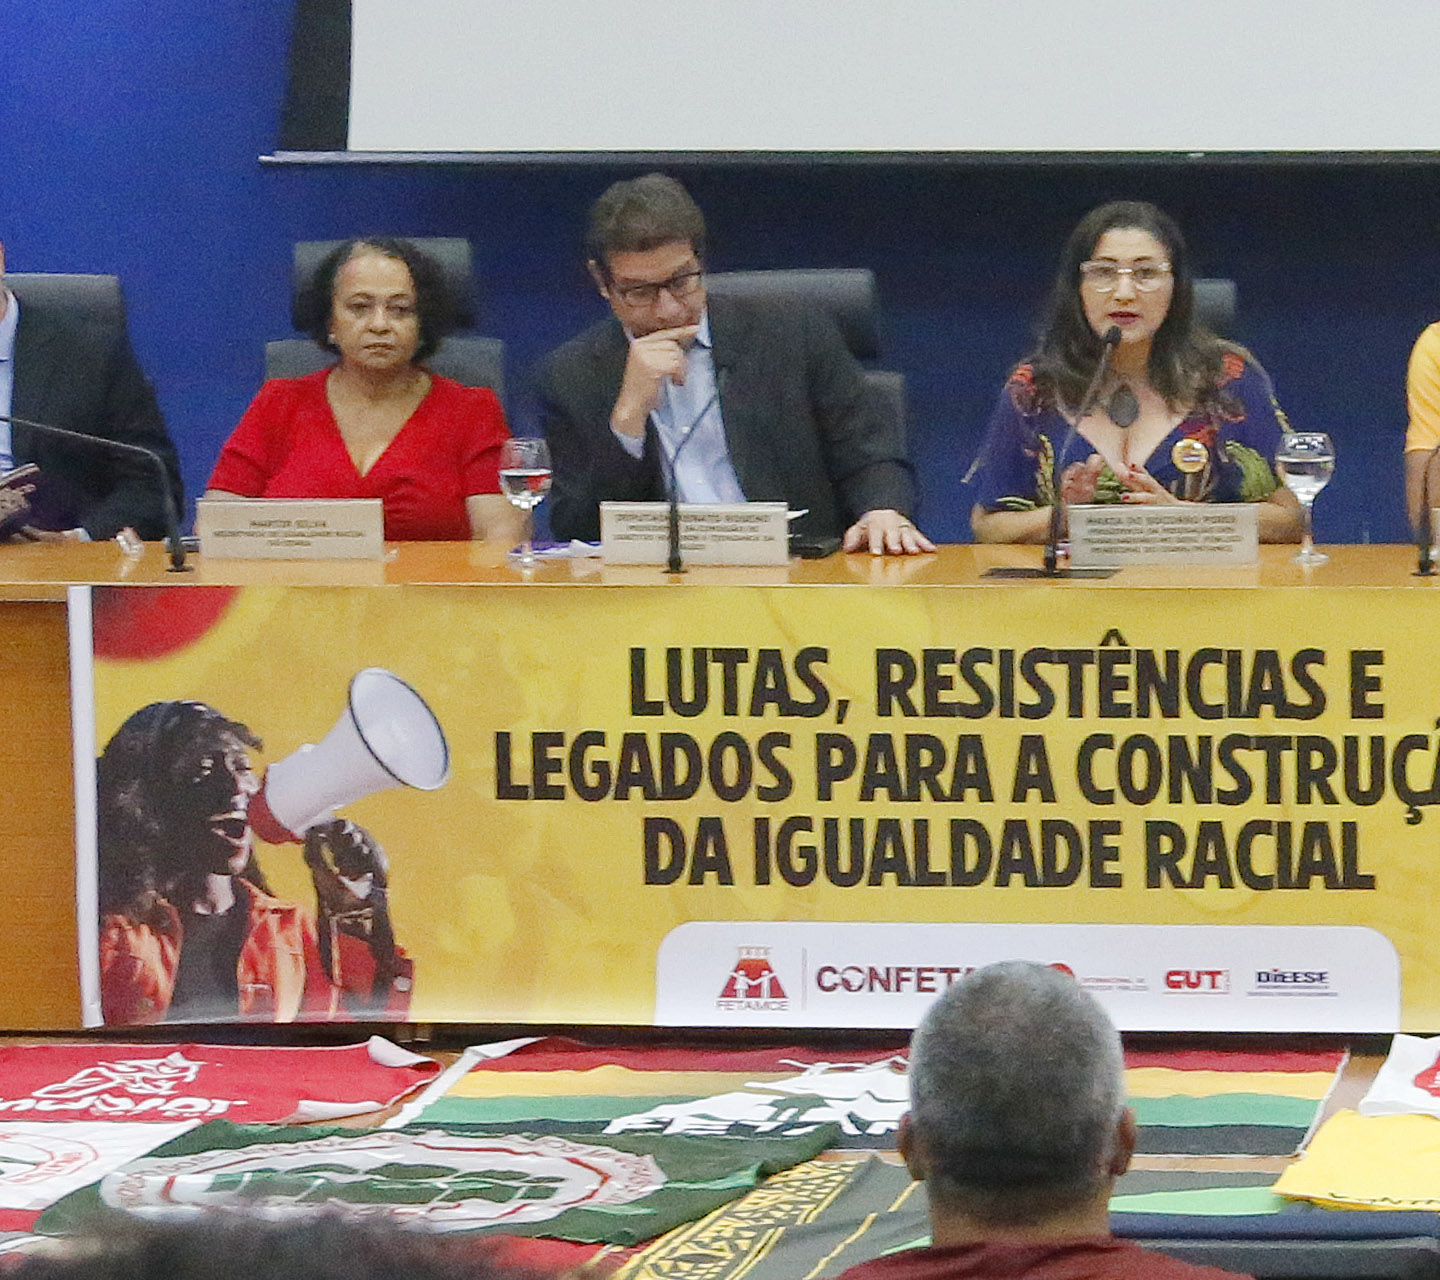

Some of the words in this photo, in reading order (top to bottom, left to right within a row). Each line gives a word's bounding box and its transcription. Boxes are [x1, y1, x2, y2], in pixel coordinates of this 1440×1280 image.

[629, 646, 849, 725] LUTAS,
[875, 629, 1328, 721] RESISTÊNCIAS
[1350, 649, 1385, 720] E
[494, 730, 793, 803] LEGADOS
[817, 731, 994, 803] PARA
[1011, 732, 1059, 804] A
[643, 816, 734, 887] DA
[754, 816, 1125, 889] IGUALDADE
[1145, 820, 1377, 890] RACIAL
[816, 966, 977, 993] CONFET
[1164, 969, 1223, 990] CUT
